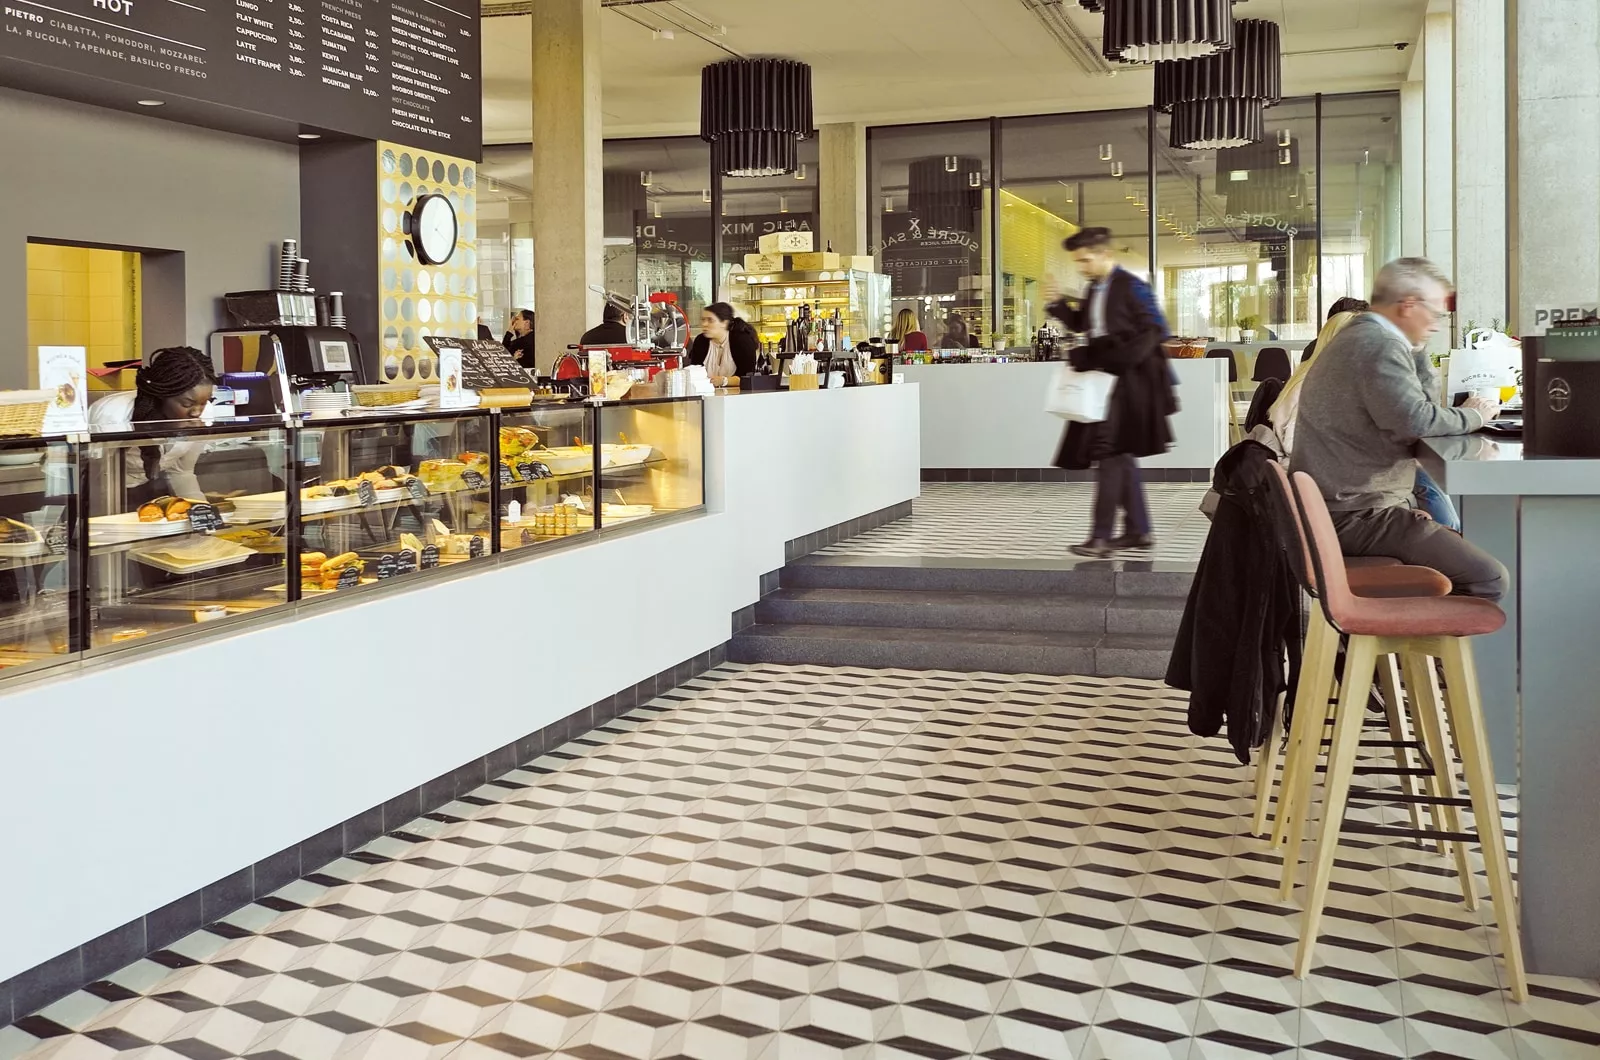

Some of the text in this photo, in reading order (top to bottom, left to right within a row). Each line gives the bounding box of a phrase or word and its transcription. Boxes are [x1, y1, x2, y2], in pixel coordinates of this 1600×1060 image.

[93, 0, 134, 16] HOT
[236, 0, 259, 11] LUNGO
[321, 1, 343, 14] FRENCH
[344, 9, 362, 21] PRESS
[236, 12, 252, 23] FLAT
[252, 17, 274, 30] WHITE
[321, 14, 340, 26] COSTA
[340, 19, 354, 30] RICA
[391, 14, 418, 29] BREAKFAST
[4, 6, 207, 65] PIETRO CIABATTA, POMODORI, MOZZAREL-
[236, 26, 278, 44] CAPPUCCINO
[391, 26, 408, 37] GREEN
[421, 37, 438, 47] GREEN
[6, 24, 207, 79] LA, RUCOLA, TAPENADE, BASILICO FRESCO
[236, 39, 257, 51] LATTE
[321, 39, 348, 52] SUMATRA
[391, 37, 408, 48] BOOST
[447, 57, 459, 66] LOVE
[236, 53, 257, 65] LATTE
[321, 51, 340, 63] KENYA
[322, 64, 363, 82] JAMAICAN BLUE
[322, 76, 351, 90] MOUNTAIN
[413, 79, 430, 89] FRUITS
[391, 119, 451, 139] CHOCOLATE ON THE STICK
